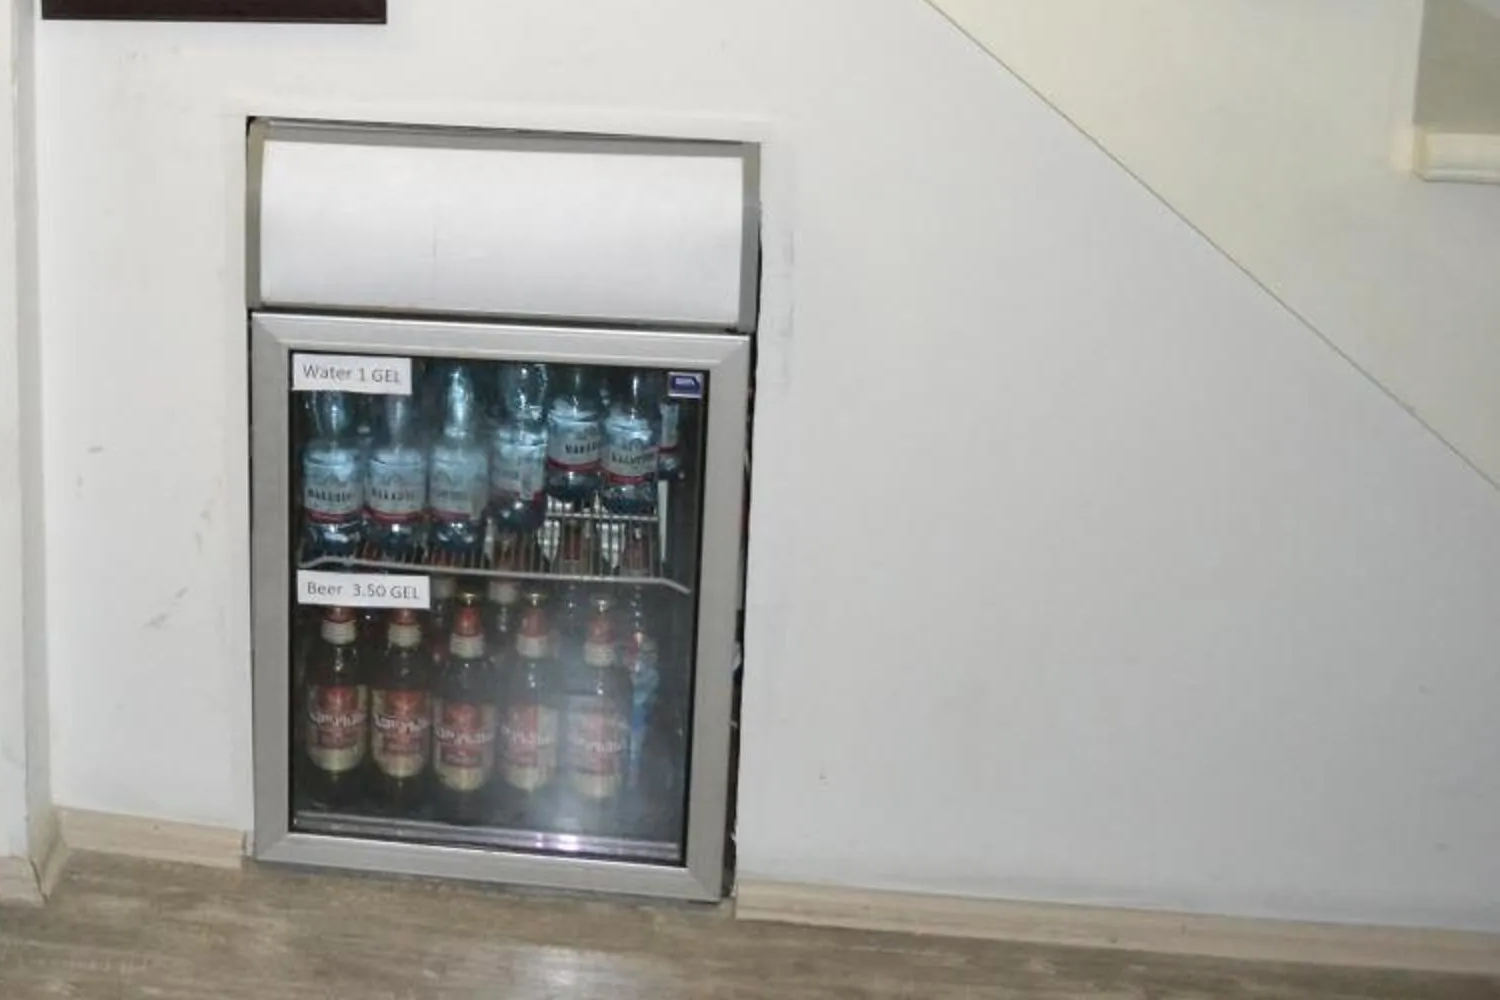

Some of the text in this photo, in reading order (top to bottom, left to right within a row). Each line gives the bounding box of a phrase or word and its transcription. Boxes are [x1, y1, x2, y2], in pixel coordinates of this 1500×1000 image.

[302, 363, 401, 384] Water 1 GEL
[307, 582, 419, 600] Beer 3.50 GEL
